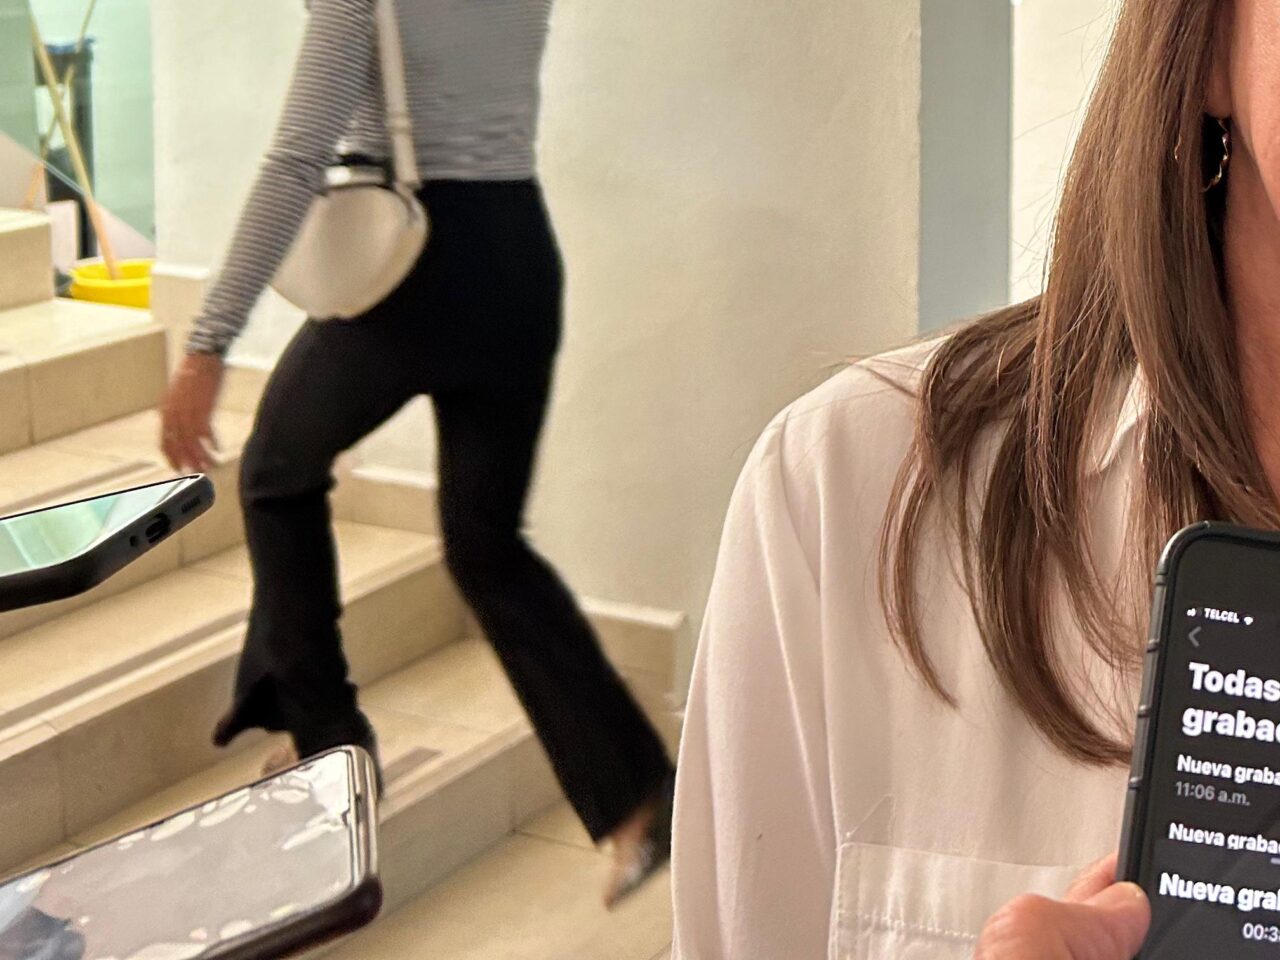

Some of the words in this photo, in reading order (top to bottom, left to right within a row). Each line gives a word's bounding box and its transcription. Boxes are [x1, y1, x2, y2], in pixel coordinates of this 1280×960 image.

[1204, 608, 1240, 623] TELCEL
[1177, 754, 1232, 779] Nueva
[1175, 781, 1215, 800] 11:06
[1217, 790, 1251, 806] a.m.
[1168, 822, 1225, 847] Nueva
[1158, 872, 1235, 905] Nueva
